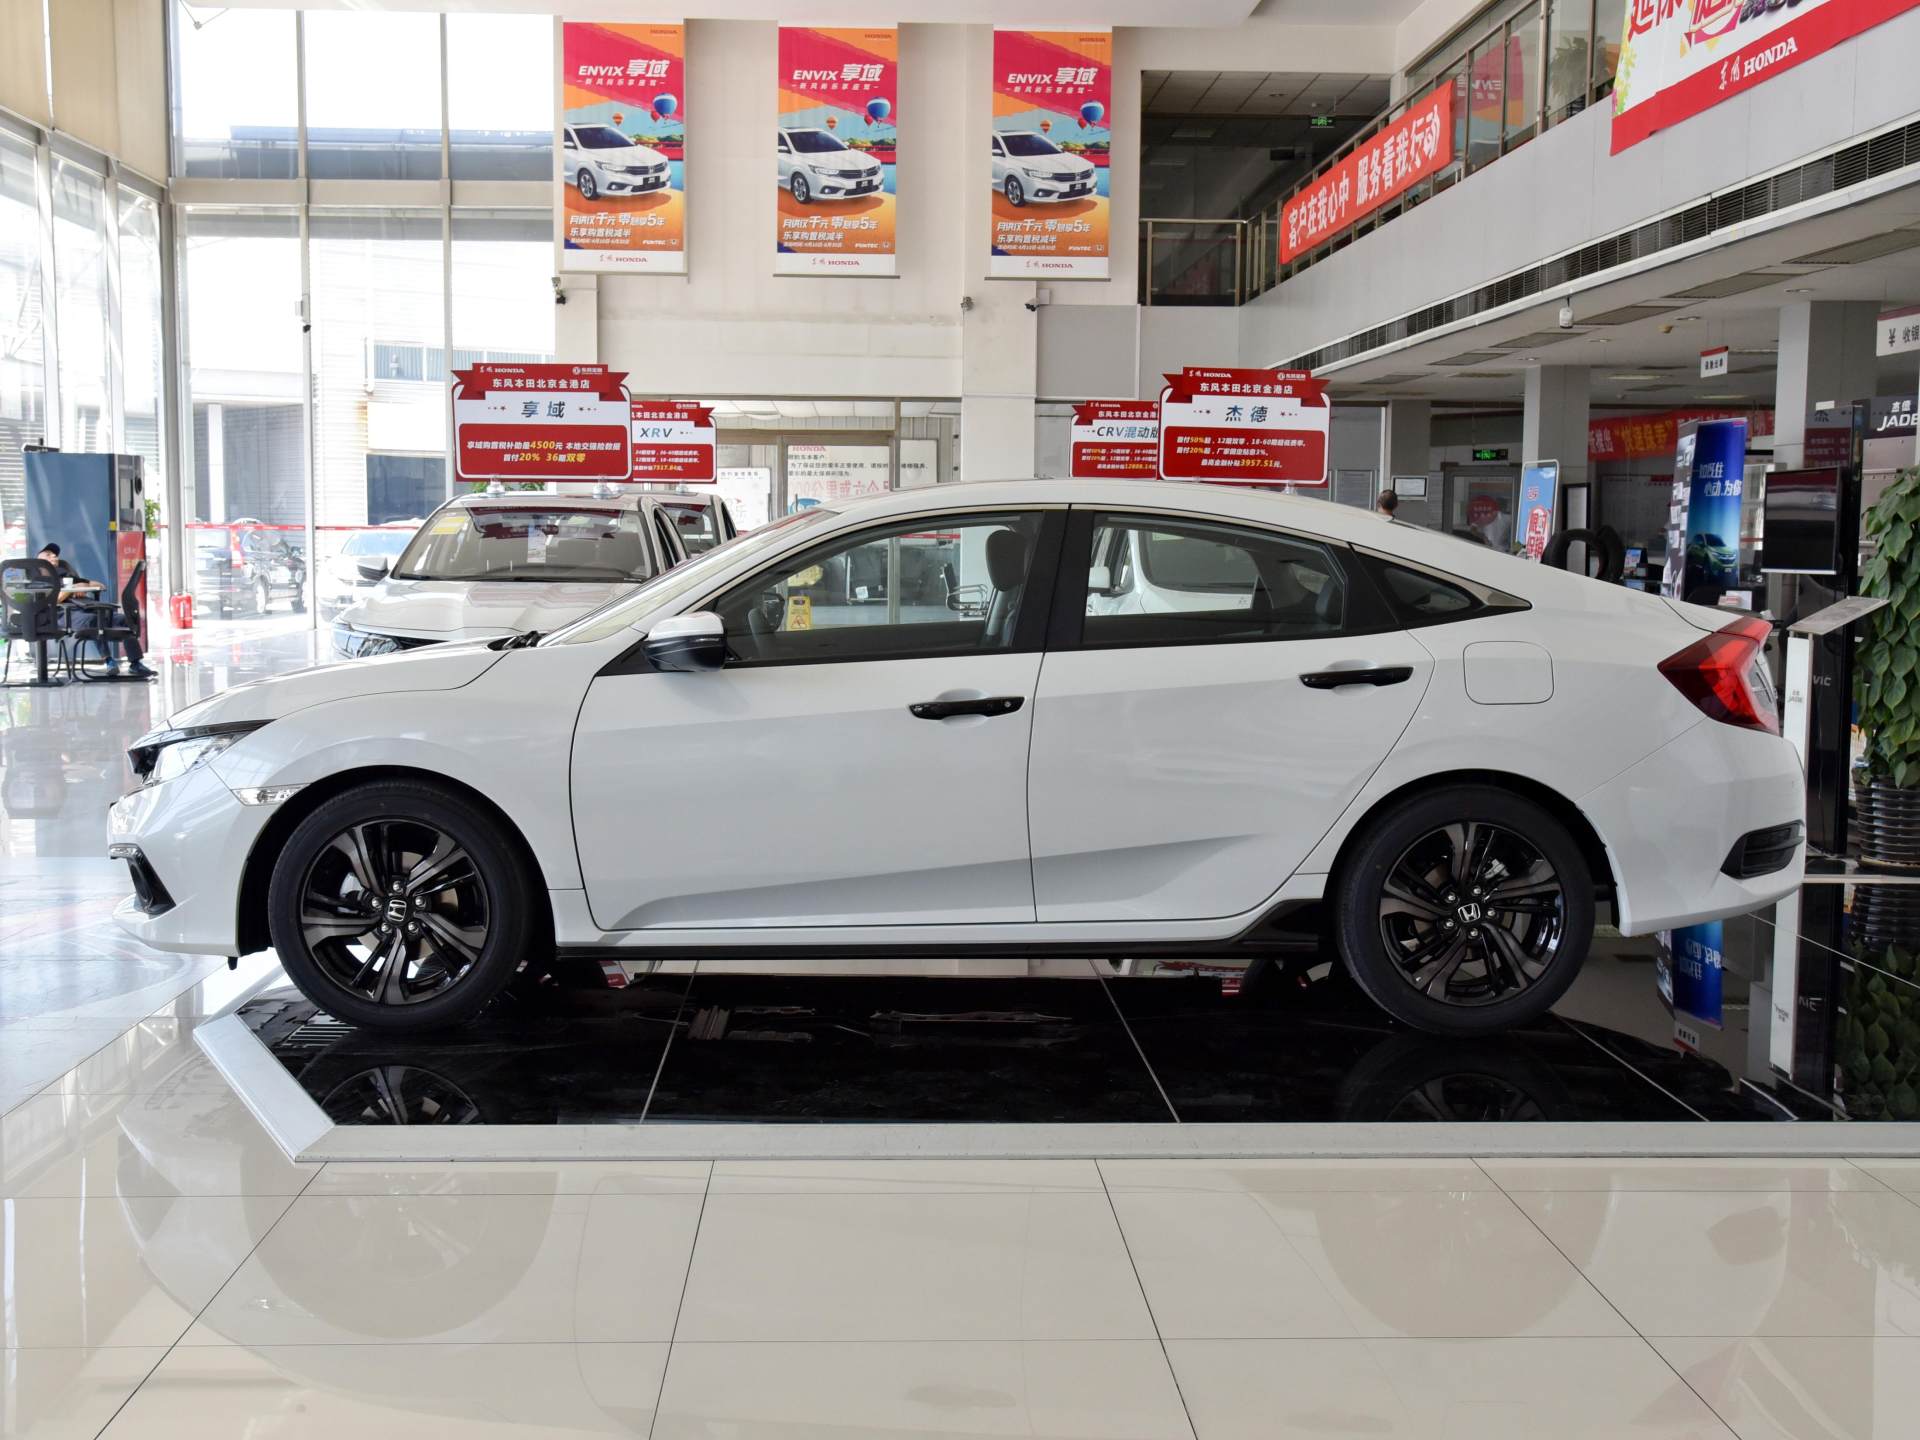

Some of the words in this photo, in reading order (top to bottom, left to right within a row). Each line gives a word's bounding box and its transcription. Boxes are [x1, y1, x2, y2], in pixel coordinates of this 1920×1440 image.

[1743, 36, 1798, 78] HONDA
[578, 65, 624, 76] ENVIX
[625, 59, 671, 77] 享域
[792, 69, 839, 80] ENVIX
[840, 63, 884, 82] 享域
[1007, 73, 1053, 84] ENVIX
[1054, 67, 1098, 85] 享域
[1288, 170, 1350, 250] 客户在我心中
[1356, 104, 1441, 206] 服务看我行动
[493, 378, 590, 389] 东风本田北京金港店
[1200, 382, 1293, 395] 东风本田北京金港店
[521, 400, 566, 418] 享域
[1225, 404, 1268, 423] 杰德
[640, 427, 673, 438] XRV
